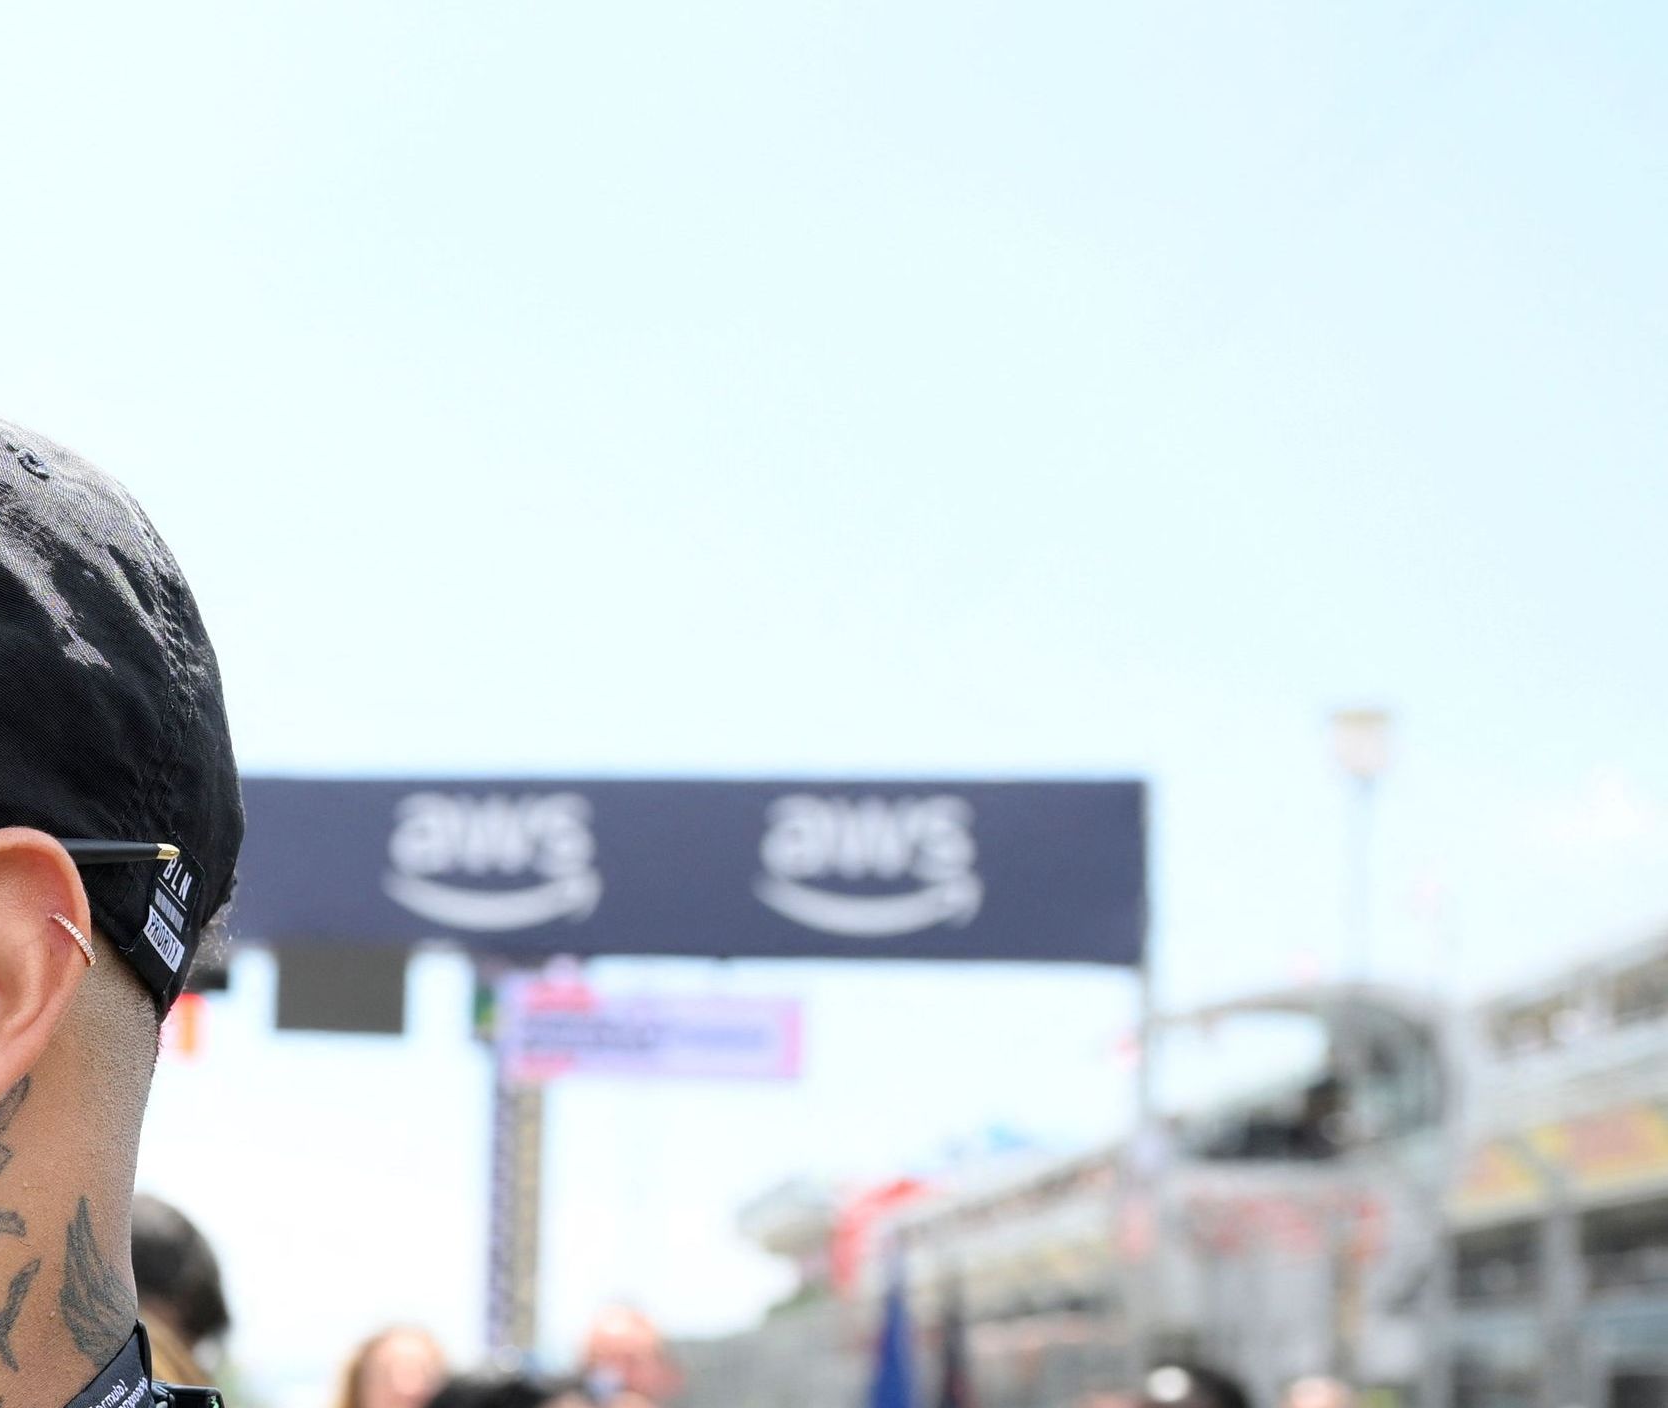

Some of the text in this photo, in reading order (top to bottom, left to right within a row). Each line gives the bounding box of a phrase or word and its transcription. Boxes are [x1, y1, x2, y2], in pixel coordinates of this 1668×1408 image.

[389, 793, 596, 882] aws
[759, 795, 975, 885] aws
[162, 857, 193, 902] BLN
[147, 911, 181, 964] PRIORITY
